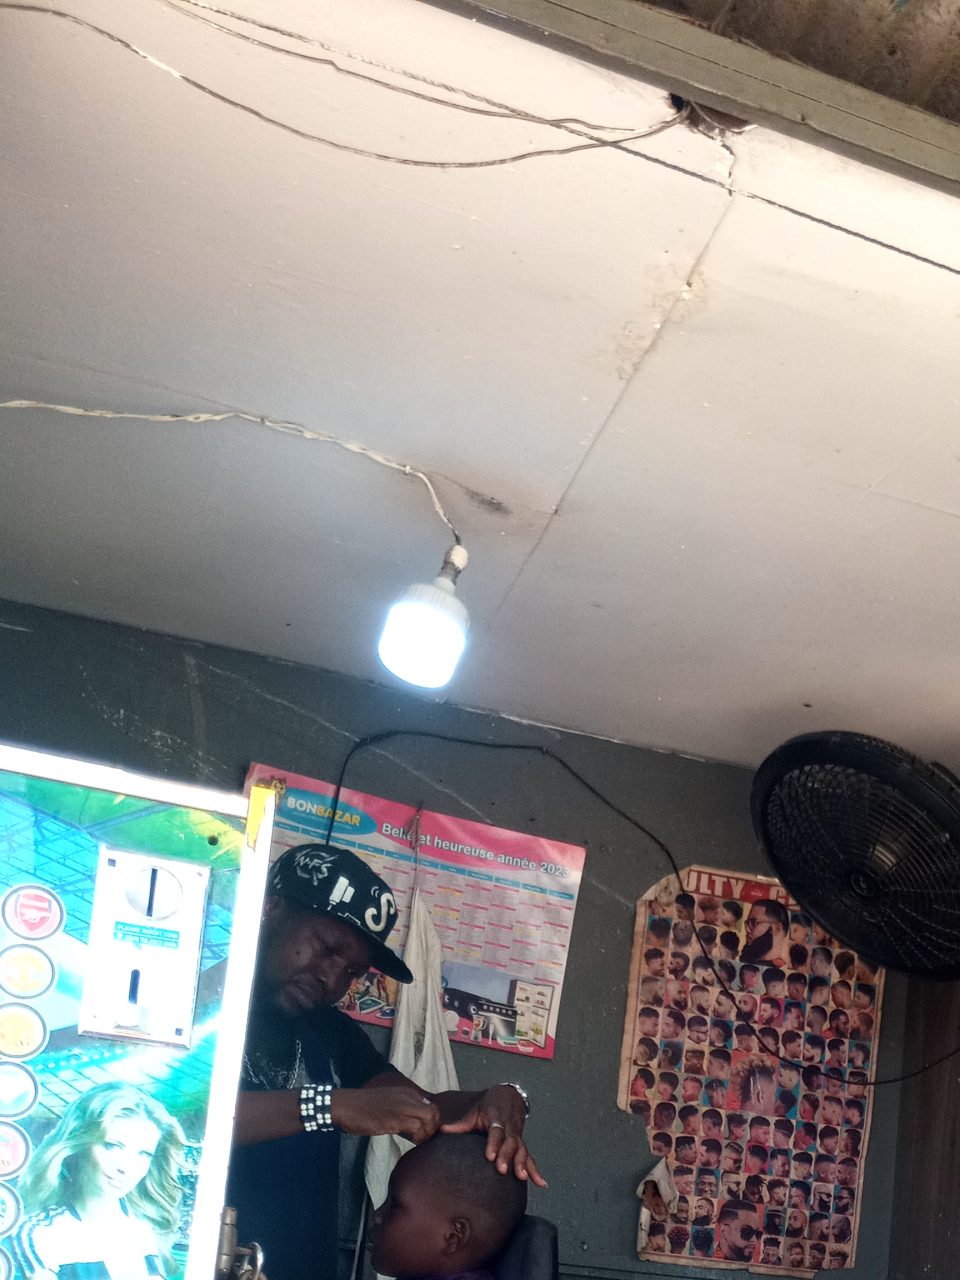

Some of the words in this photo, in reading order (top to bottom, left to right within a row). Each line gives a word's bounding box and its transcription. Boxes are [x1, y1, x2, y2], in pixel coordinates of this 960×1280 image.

[418, 831, 432, 846] et
[434, 837, 499, 861] heureuse
[497, 852, 537, 871] année
[540, 861, 571, 878] 2023
